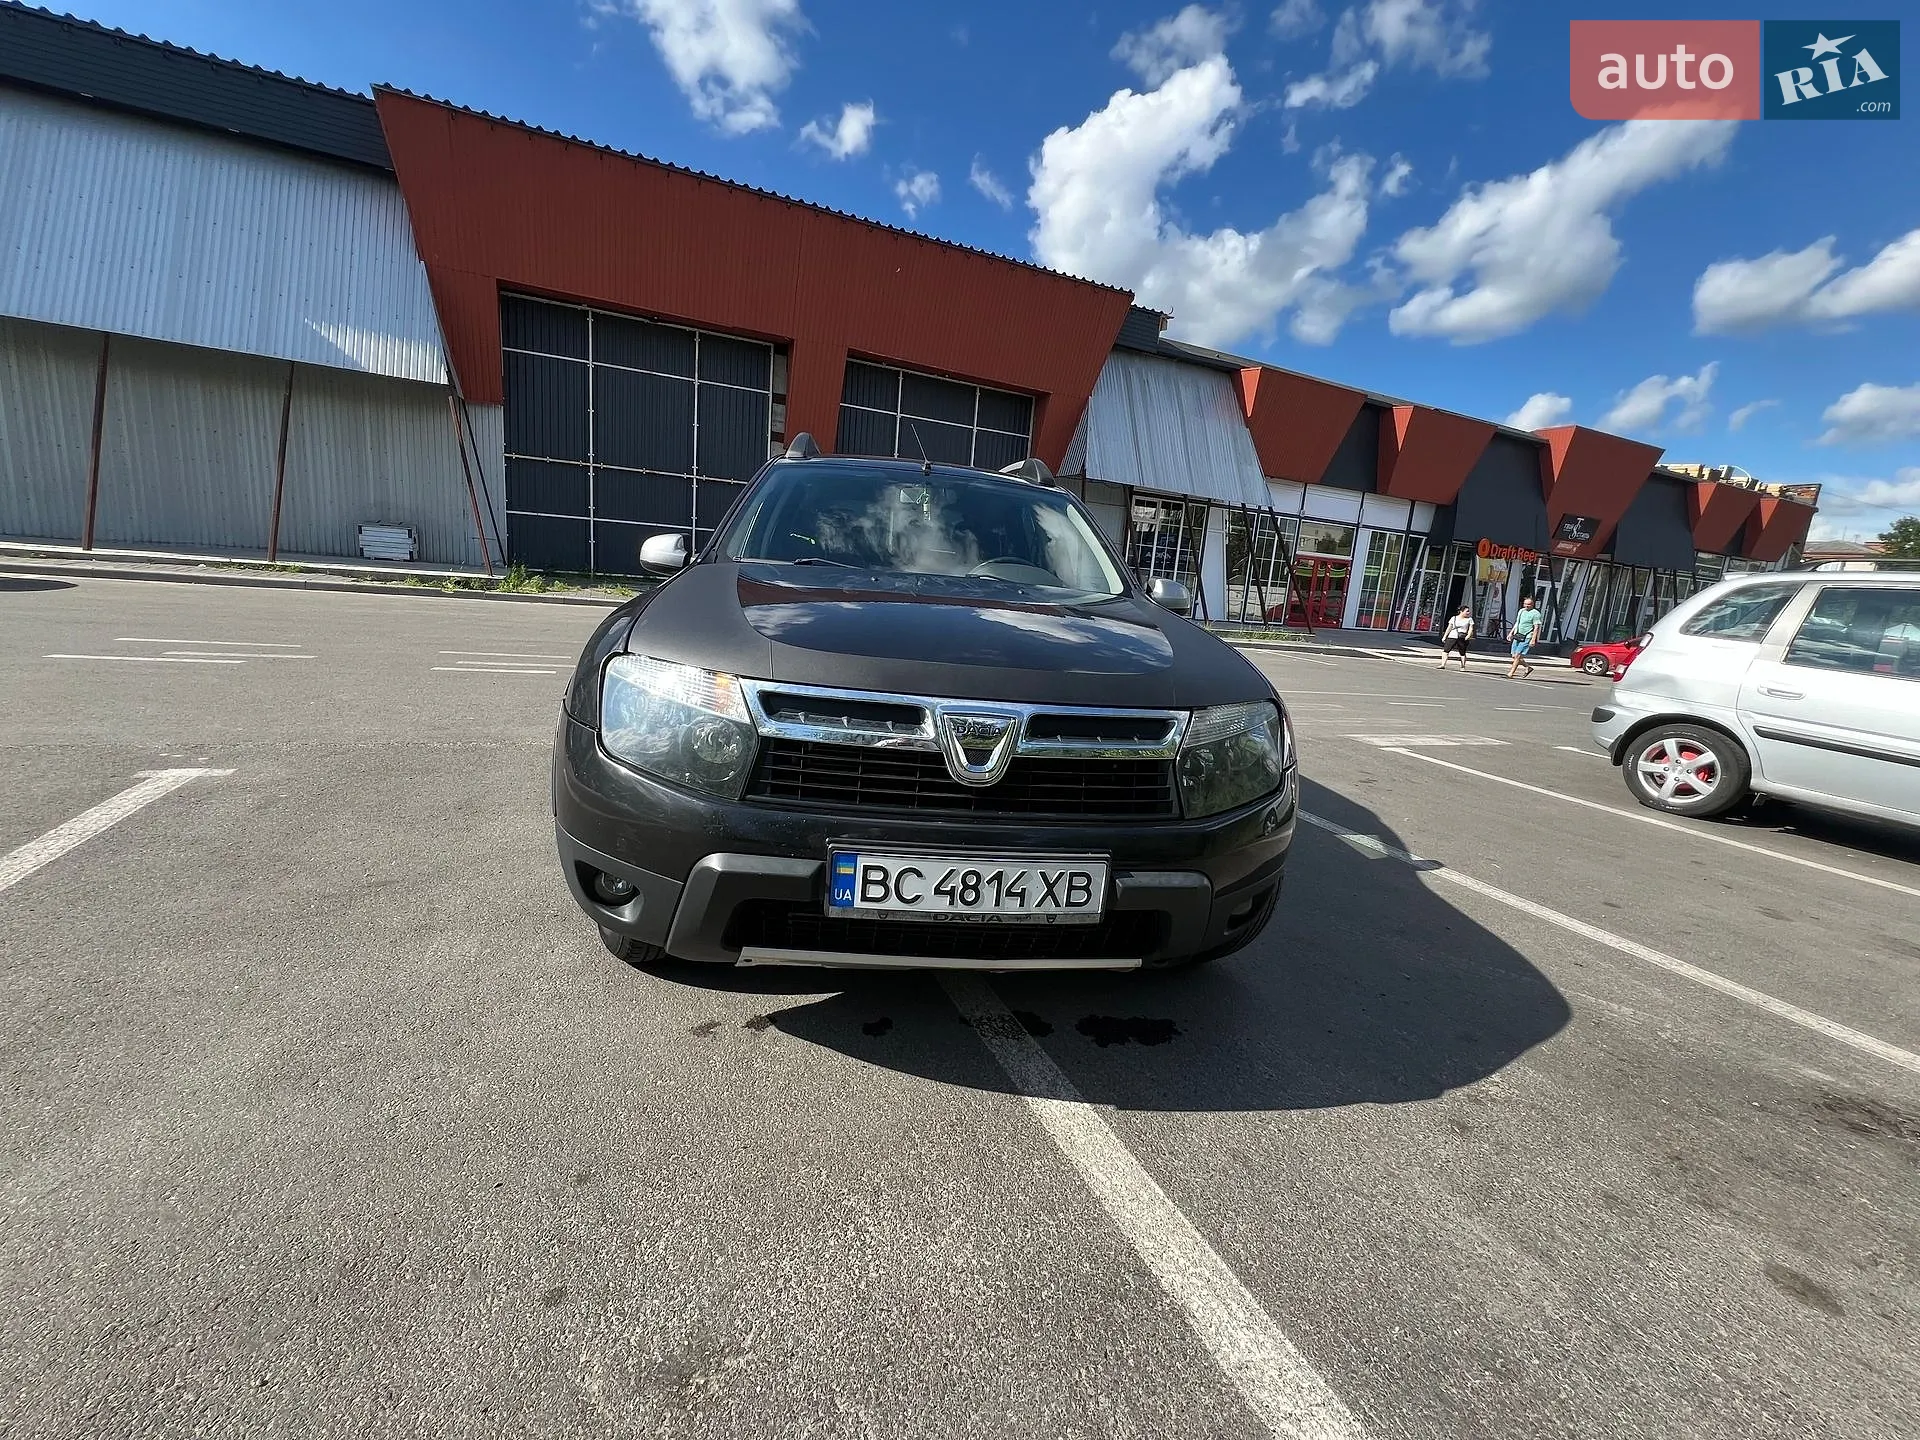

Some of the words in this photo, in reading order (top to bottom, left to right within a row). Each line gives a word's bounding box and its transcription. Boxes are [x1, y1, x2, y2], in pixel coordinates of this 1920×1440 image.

[956, 725, 1001, 736] DACIA
[859, 864, 925, 904] BC
[932, 868, 1027, 908] 4814
[1032, 870, 1093, 908] XB
[834, 888, 851, 901] UA
